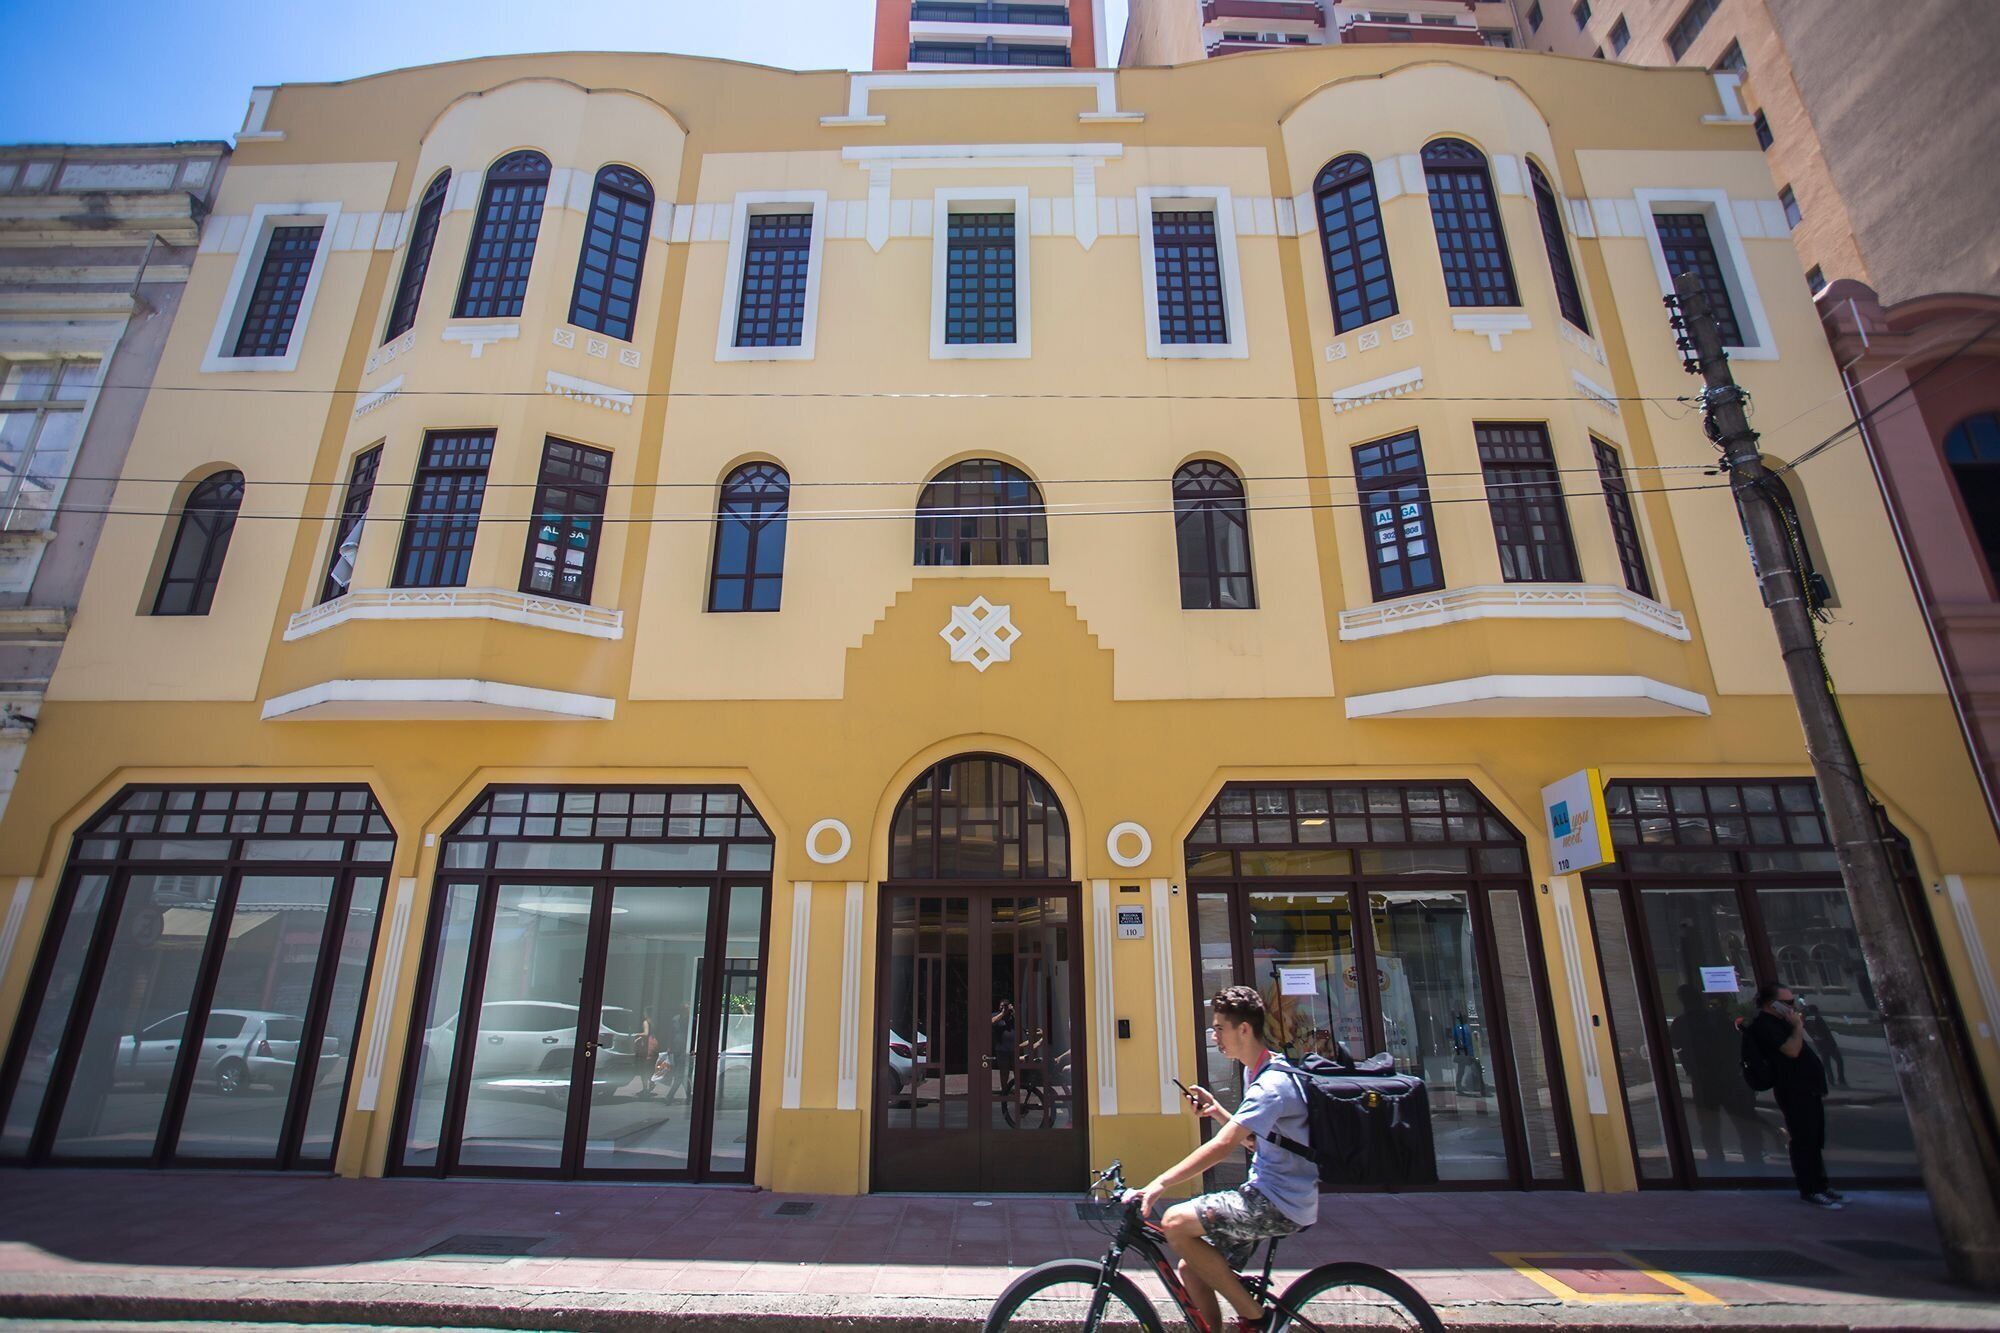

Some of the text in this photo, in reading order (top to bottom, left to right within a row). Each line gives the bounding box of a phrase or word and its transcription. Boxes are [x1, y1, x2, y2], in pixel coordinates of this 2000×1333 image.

[1379, 505, 1417, 523] ALGA
[1553, 812, 1569, 828] ALL
[1558, 858, 1570, 871] 110
